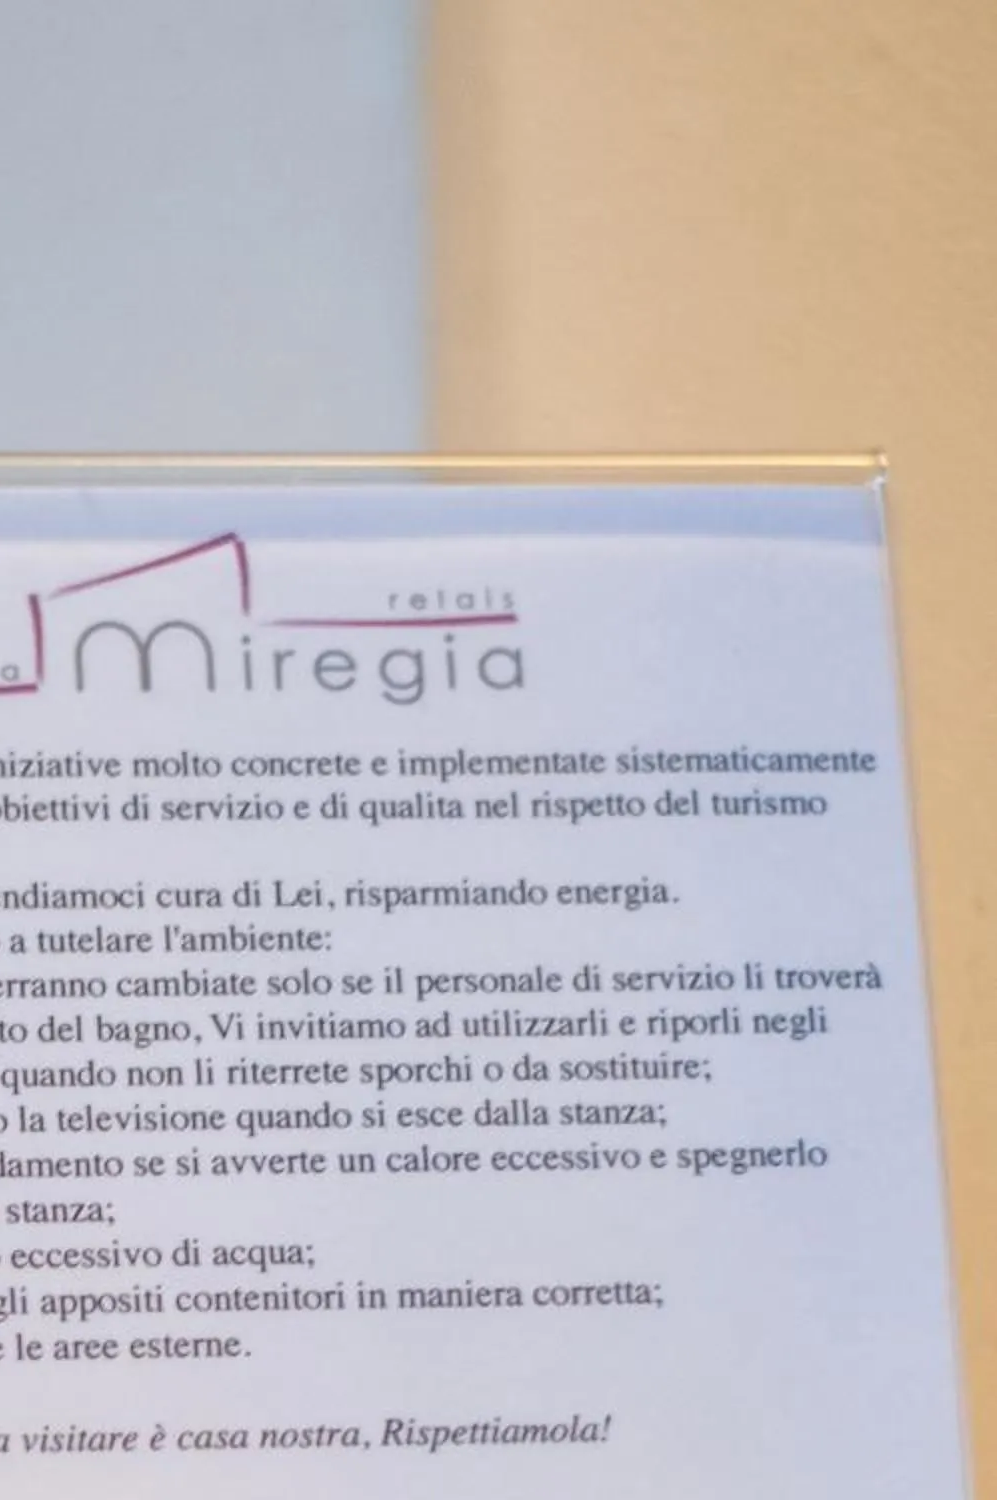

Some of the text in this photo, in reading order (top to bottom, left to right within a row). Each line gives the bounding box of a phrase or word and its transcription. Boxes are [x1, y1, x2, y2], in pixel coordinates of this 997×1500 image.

[388, 587, 517, 612] relais
[131, 748, 224, 779] molto
[230, 752, 363, 778] concrete
[397, 746, 607, 784] implementate
[615, 743, 877, 776] sistematicamente
[119, 792, 150, 822] di
[160, 792, 285, 823] servizio
[318, 791, 349, 821] di
[358, 790, 466, 828] qualita
[474, 790, 521, 820] nel
[530, 790, 647, 827] rispetto
[653, 788, 701, 818] del
[710, 787, 829, 817] turismo
[154, 886, 224, 910] cura
[231, 879, 263, 909] di
[272, 878, 336, 912] Lei,
[344, 876, 549, 915] risparmiando
[555, 875, 680, 913] energia.
[36, 923, 154, 955] tutelare
[163, 921, 332, 955] l'ambiente:
[115, 966, 258, 1000] cambiate
[266, 965, 334, 997] solo
[414, 964, 563, 1003] personale
[571, 963, 603, 994] di
[611, 962, 736, 993] servizio
[774, 961, 884, 991] troverà
[36, 1013, 84, 1044] del
[95, 1012, 203, 1051] bagno,
[208, 1011, 246, 1041] Vi
[256, 1009, 408, 1041] invitiamo
[414, 1009, 453, 1040] ad
[461, 1007, 610, 1039] utilizzarli
[646, 1006, 743, 1044] riporli
[751, 1005, 829, 1043] negli
[0, 1058, 118, 1097] quando
[126, 1064, 185, 1089] non
[226, 1055, 350, 1088] riterrete
[358, 1054, 474, 1093] sporchi
[511, 1052, 552, 1083] da
[558, 1050, 713, 1085] sostituire;
[55, 1102, 227, 1135] televisione
[235, 1099, 354, 1139] quando
[395, 1105, 465, 1129] esce
[472, 1096, 551, 1128] dalla
[558, 1101, 668, 1130] stanza;
[210, 1151, 328, 1177] avverte
[336, 1151, 377, 1176] un
[384, 1142, 482, 1175] calore
[490, 1140, 642, 1173] eccessivo
[676, 1137, 829, 1177] spegnerlo
[4, 1198, 116, 1228] stanza;
[9, 1238, 164, 1271] eccessivo
[170, 1237, 203, 1269] di
[211, 1243, 316, 1275] acqua;
[39, 1283, 165, 1325] appositi
[174, 1280, 346, 1314] contenitori
[356, 1278, 388, 1311] in
[396, 1279, 525, 1310] maniera
[531, 1280, 664, 1311] corretta;
[52, 1338, 120, 1361] aree
[128, 1333, 252, 1361] esterne.
[18, 1422, 141, 1455] visitare
[174, 1428, 252, 1452] casa
[257, 1424, 375, 1452] nostra,
[379, 1412, 611, 1456] Rispettiamola!
